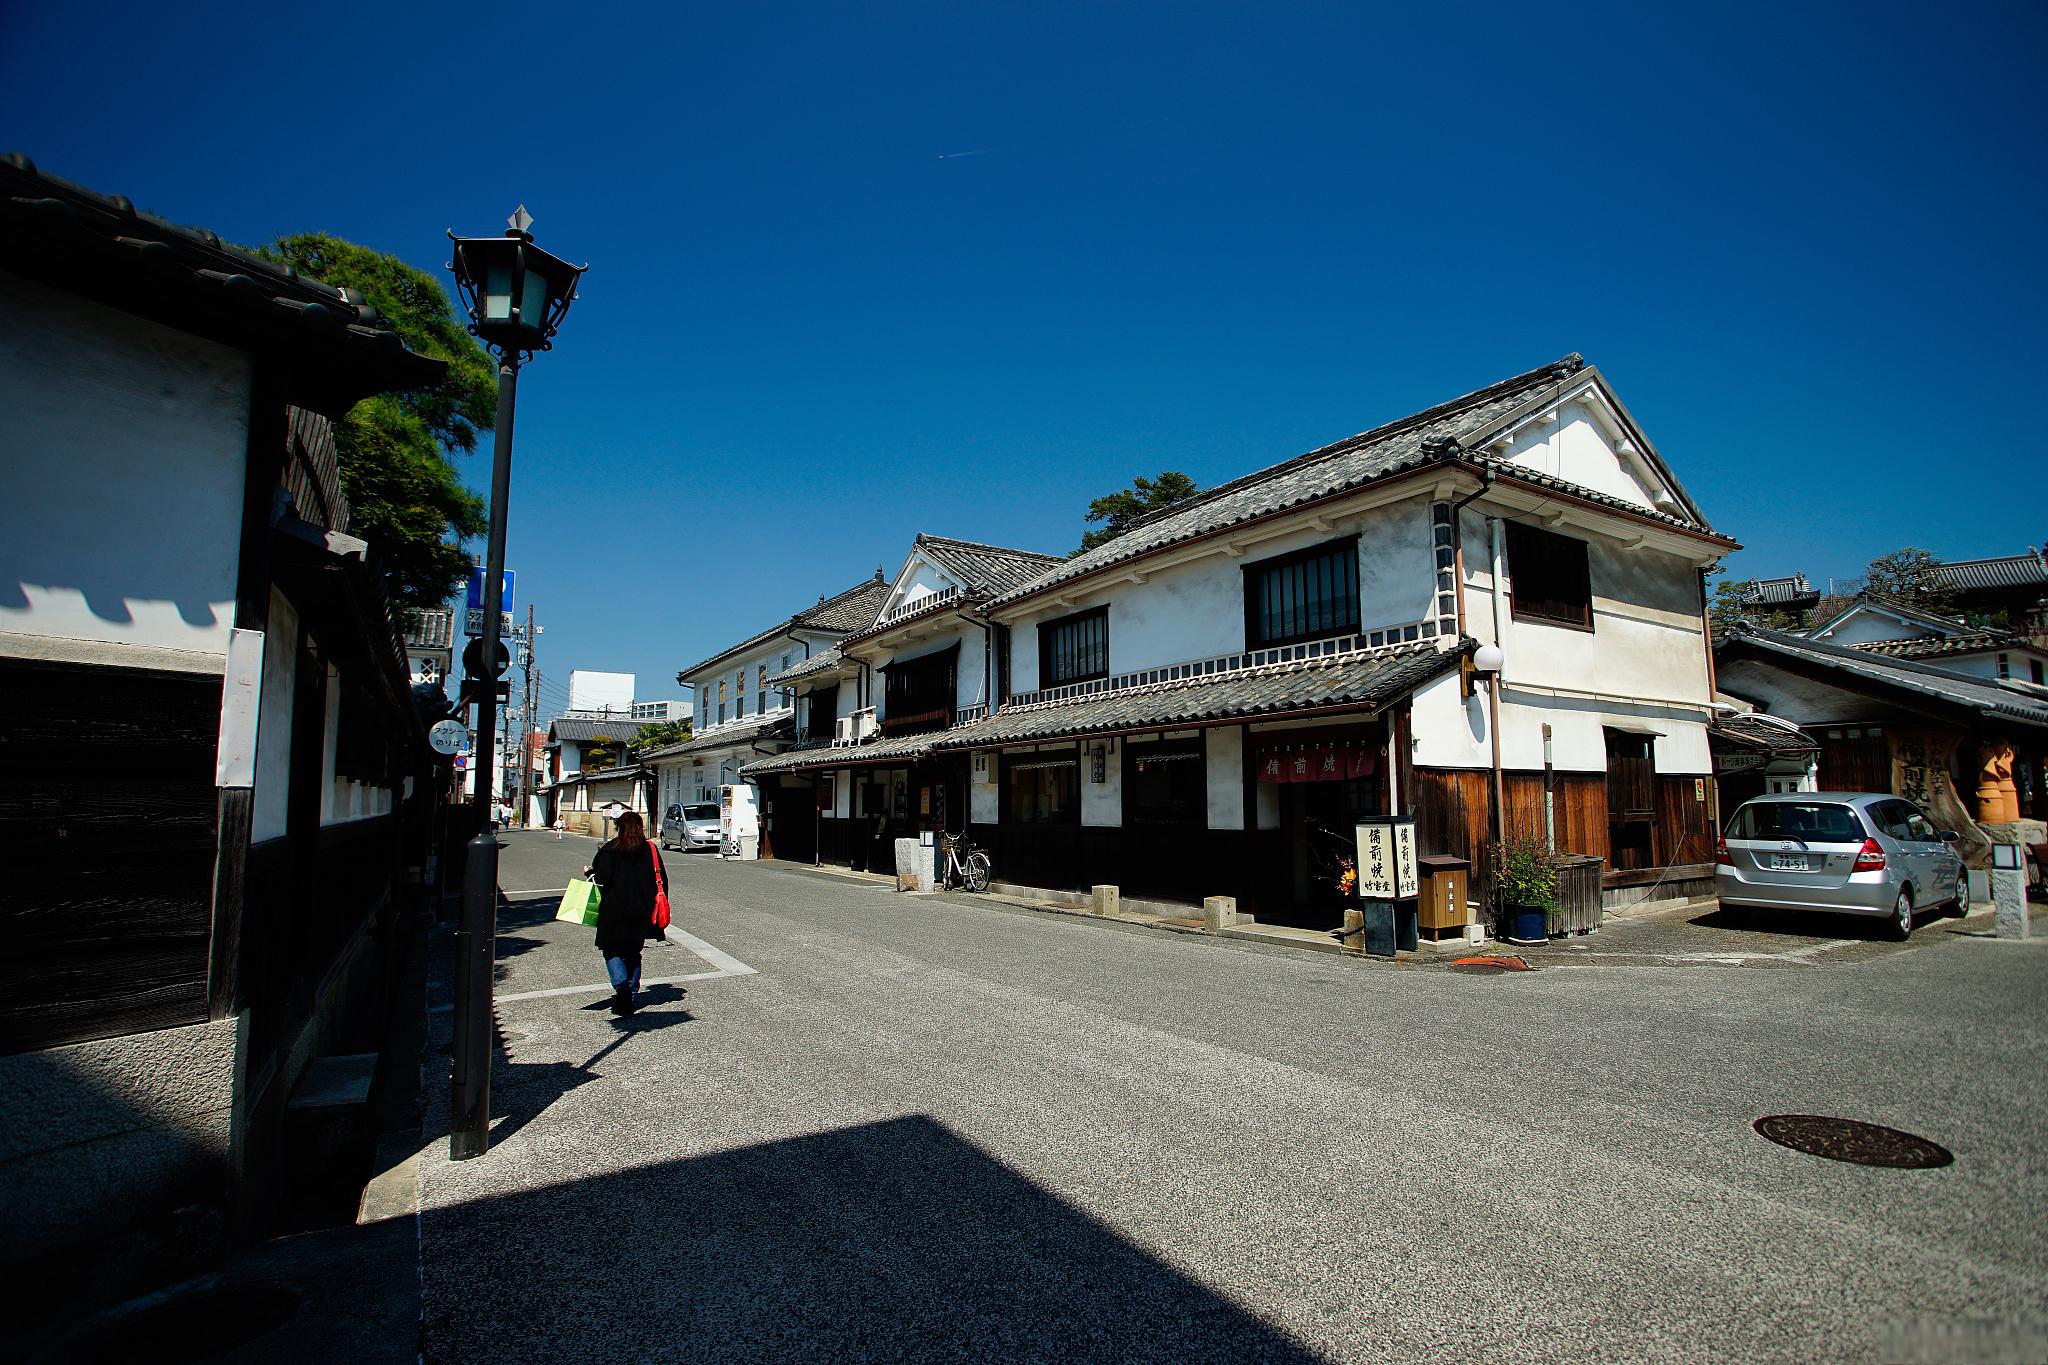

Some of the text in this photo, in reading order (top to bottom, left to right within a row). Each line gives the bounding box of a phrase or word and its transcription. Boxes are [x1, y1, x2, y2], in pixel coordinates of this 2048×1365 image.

[434, 727, 464, 735] タクシー
[435, 739, 462, 747] のりば
[1368, 828, 1384, 879] 備前焼
